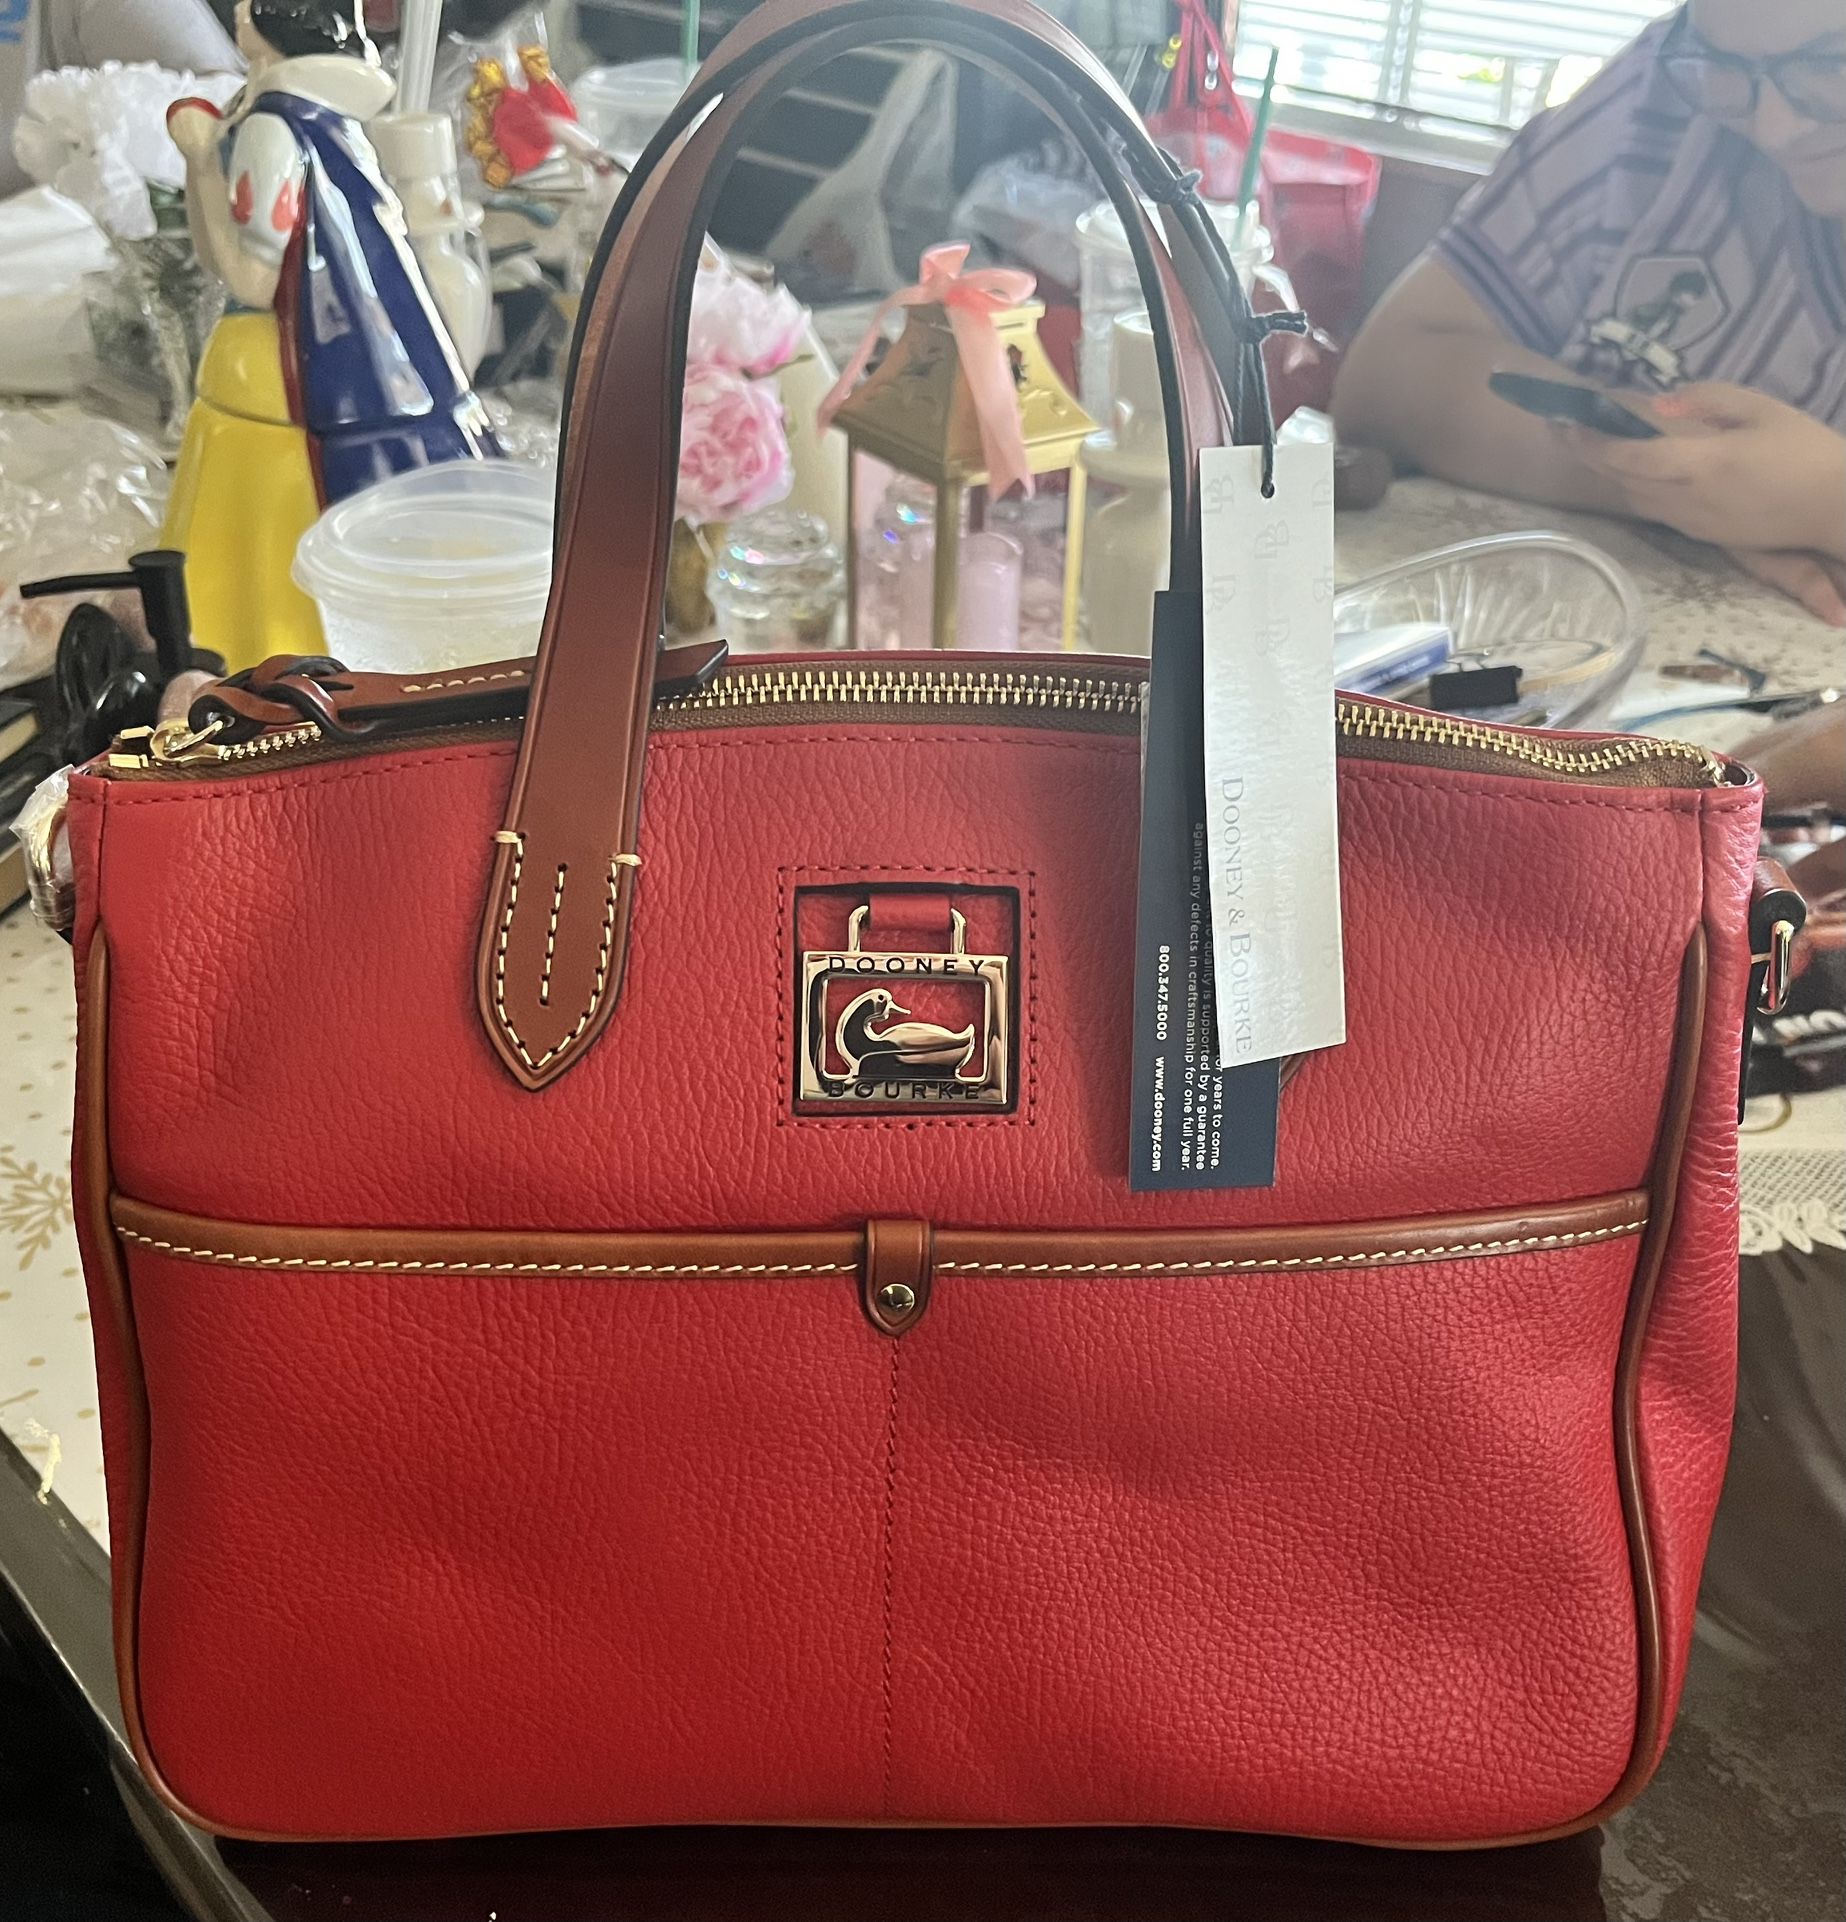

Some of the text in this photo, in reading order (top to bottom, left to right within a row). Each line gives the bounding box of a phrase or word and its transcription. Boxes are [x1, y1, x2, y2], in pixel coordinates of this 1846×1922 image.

[1222, 777, 1252, 1054] DOONEY & BOURKE
[828, 956, 985, 975] DOONEY
[1202, 941, 1214, 986] quality
[1180, 822, 1204, 1170] against any defects in craftsmanship for one full year.
[1203, 990, 1213, 1000] is
[1200, 1004, 1211, 1071] supported
[1151, 945, 1170, 1172] 800.347.5000 www.dooney.com
[828, 1081, 980, 1100] BOURKE
[1197, 1075, 1210, 1091] by
[1199, 1094, 1207, 1102] a
[1213, 1076, 1223, 1110] years
[1196, 1105, 1207, 1170] guarantee
[1212, 1114, 1223, 1128] to
[1210, 1131, 1221, 1170] come.
